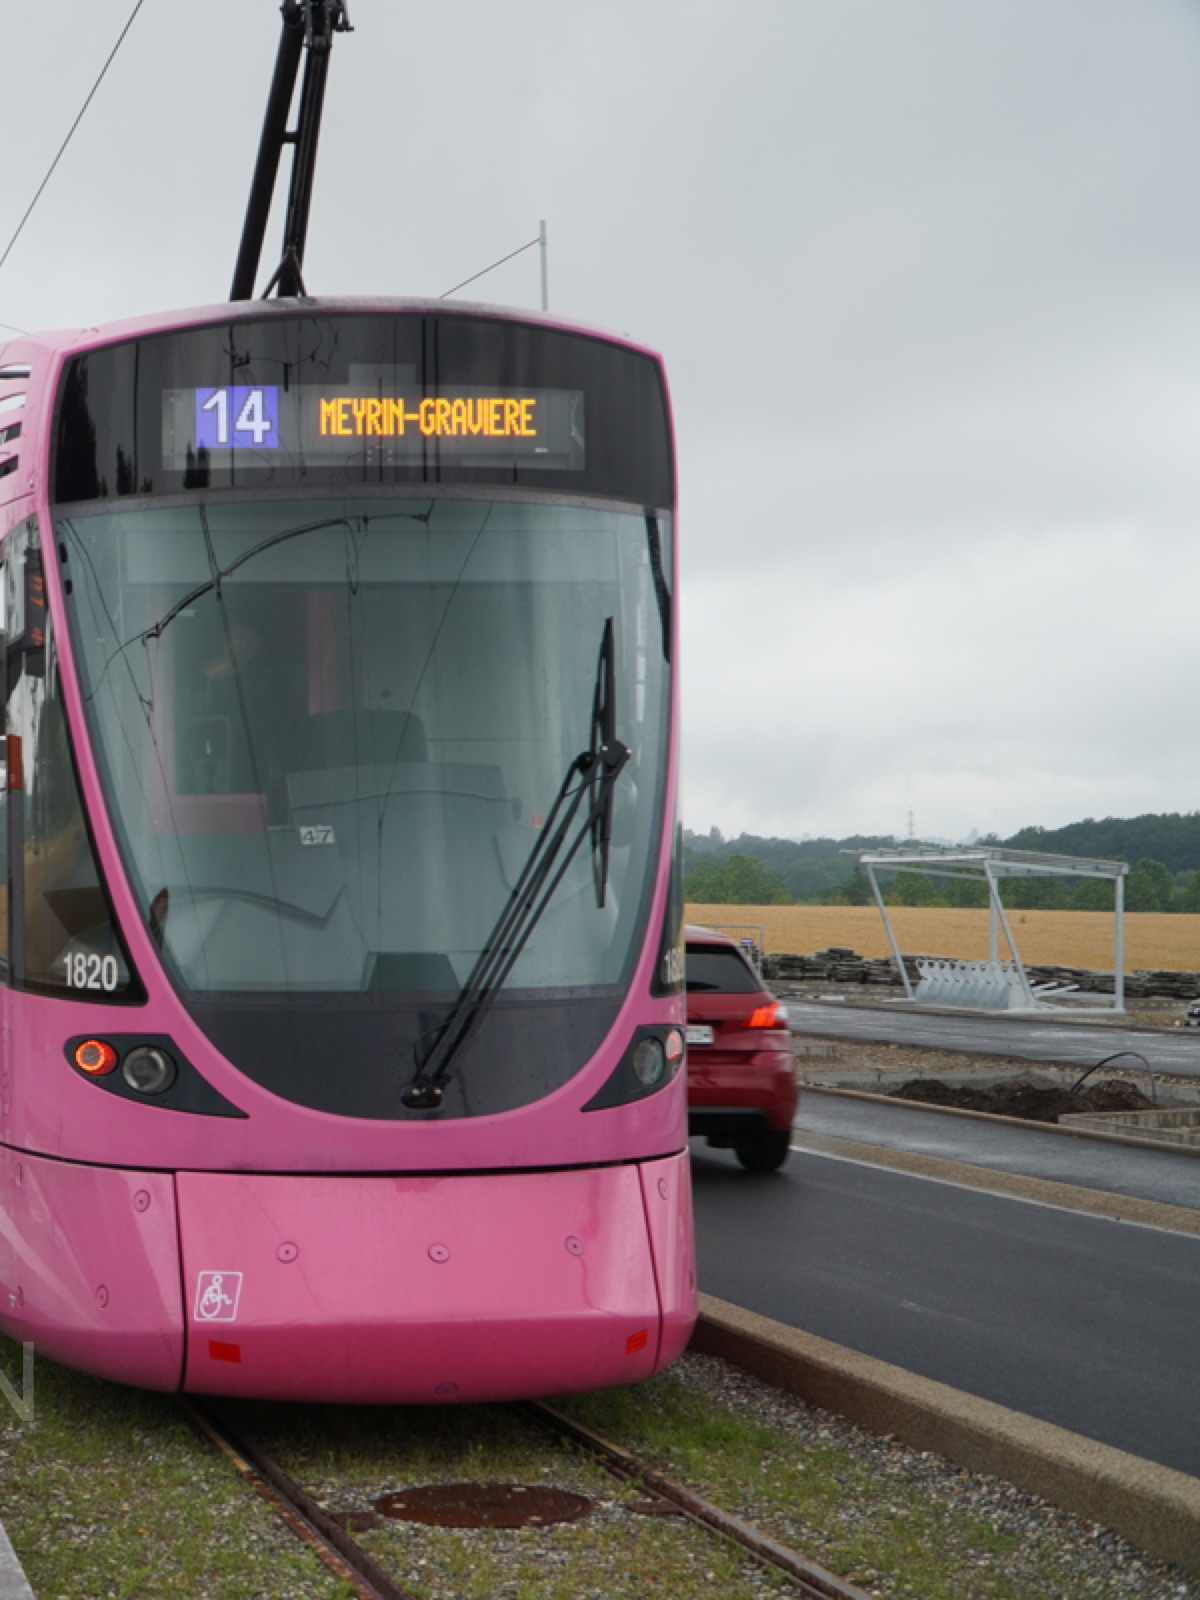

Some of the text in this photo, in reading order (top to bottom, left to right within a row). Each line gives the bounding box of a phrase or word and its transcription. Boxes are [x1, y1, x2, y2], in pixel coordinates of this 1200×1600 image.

[202, 389, 537, 444] 14 MEYRIN-GRAVIERE
[63, 951, 118, 991] 1820
